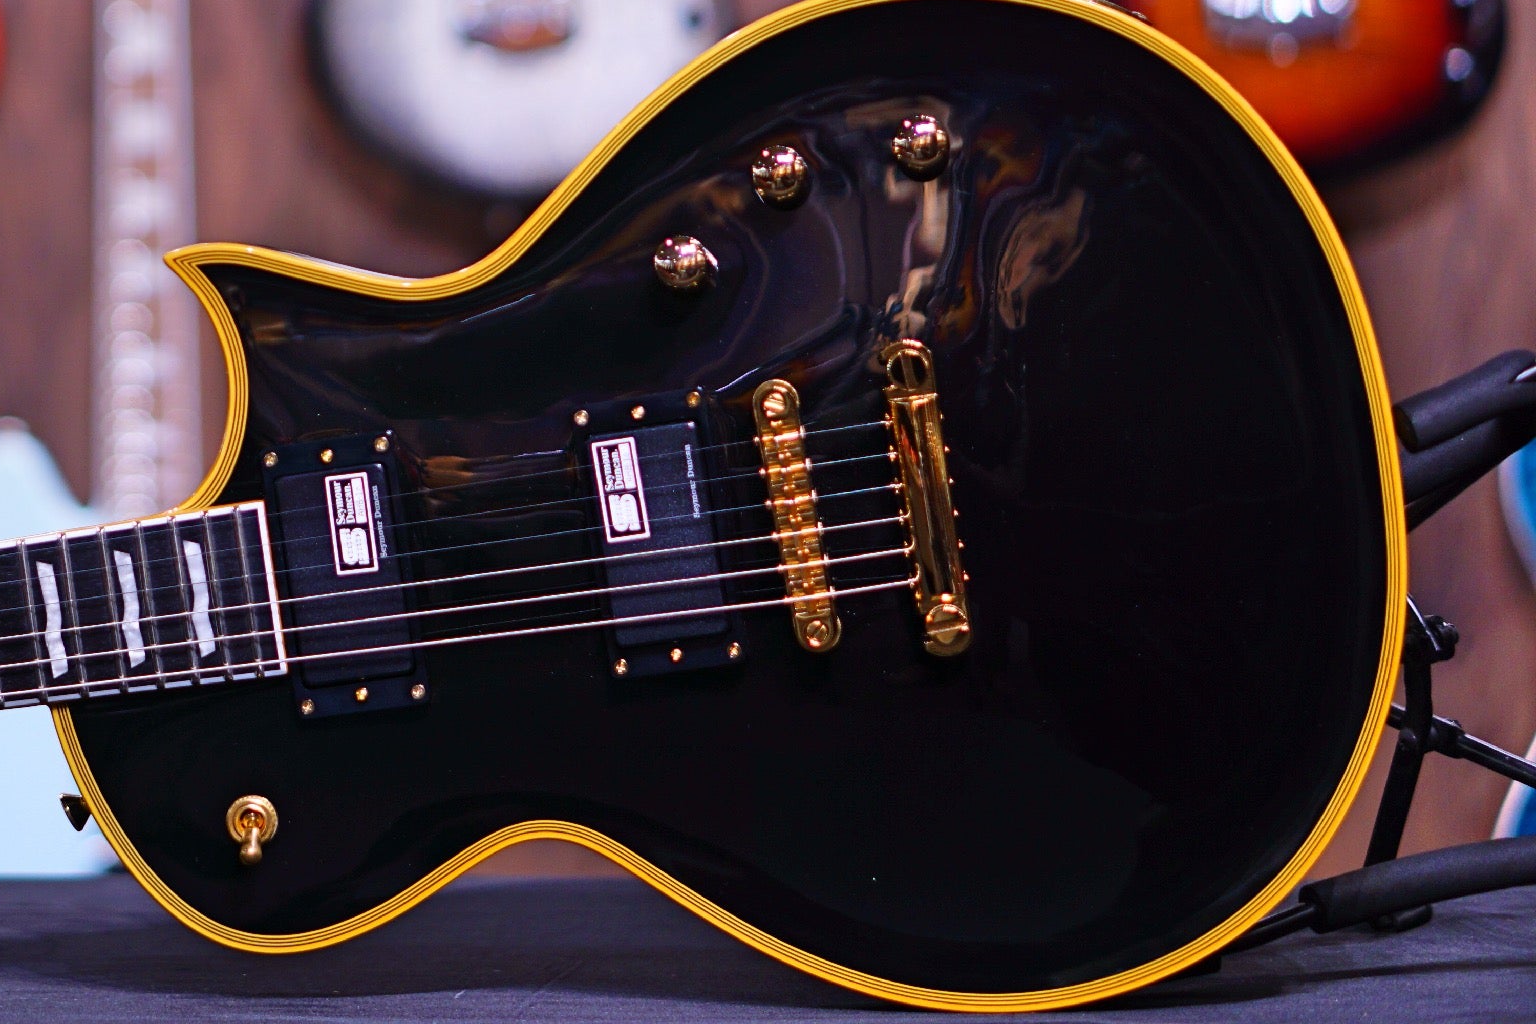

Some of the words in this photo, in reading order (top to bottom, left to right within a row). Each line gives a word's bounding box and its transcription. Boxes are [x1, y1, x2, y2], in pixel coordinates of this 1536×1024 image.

[600, 446, 615, 491] Seymour
[684, 444, 695, 478] Duncan
[333, 480, 346, 525] Seymour
[372, 485, 382, 519] Duncan
[690, 479, 701, 519] Seymour
[377, 521, 388, 558] Seymour
